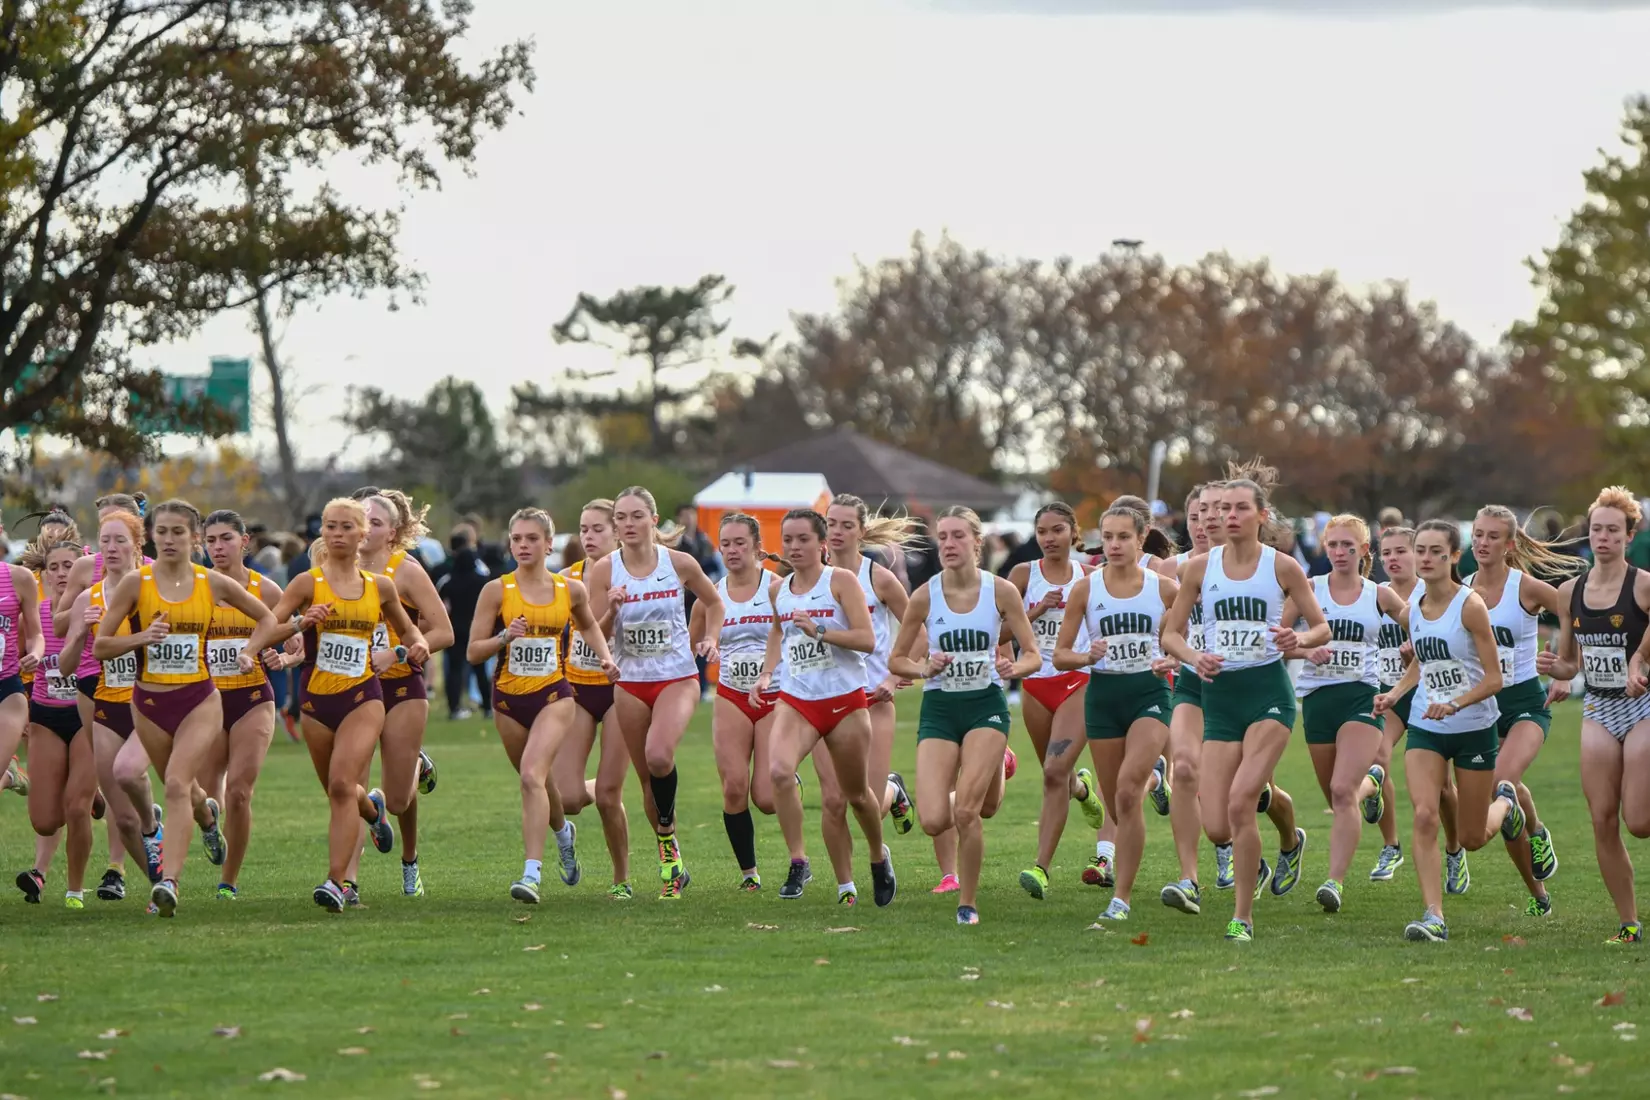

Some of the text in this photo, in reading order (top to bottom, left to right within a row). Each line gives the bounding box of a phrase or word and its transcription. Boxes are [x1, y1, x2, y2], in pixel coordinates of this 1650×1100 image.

[622, 589, 679, 603] ALL STATE
[806, 607, 835, 618] TATE
[1214, 596, 1267, 622] OHIO
[1038, 620, 1062, 636] 30
[1099, 612, 1153, 637] OHIO
[628, 629, 666, 645] 3031
[938, 628, 990, 652] OHIO
[1193, 634, 1206, 650] 31
[1221, 630, 1261, 647] 3172
[1491, 625, 1515, 648] IO
[153, 643, 194, 660] 3092
[210, 647, 244, 663] 309
[324, 642, 361, 663] 3091
[515, 646, 551, 663] 3097
[791, 641, 825, 661] 3024
[1108, 641, 1148, 661] 3164
[1415, 636, 1452, 662] OHIO
[108, 657, 136, 674] 309
[1323, 650, 1360, 667] 165
[1587, 656, 1622, 673] 3218
[946, 661, 983, 678] 3167
[1427, 668, 1462, 689] 3166
